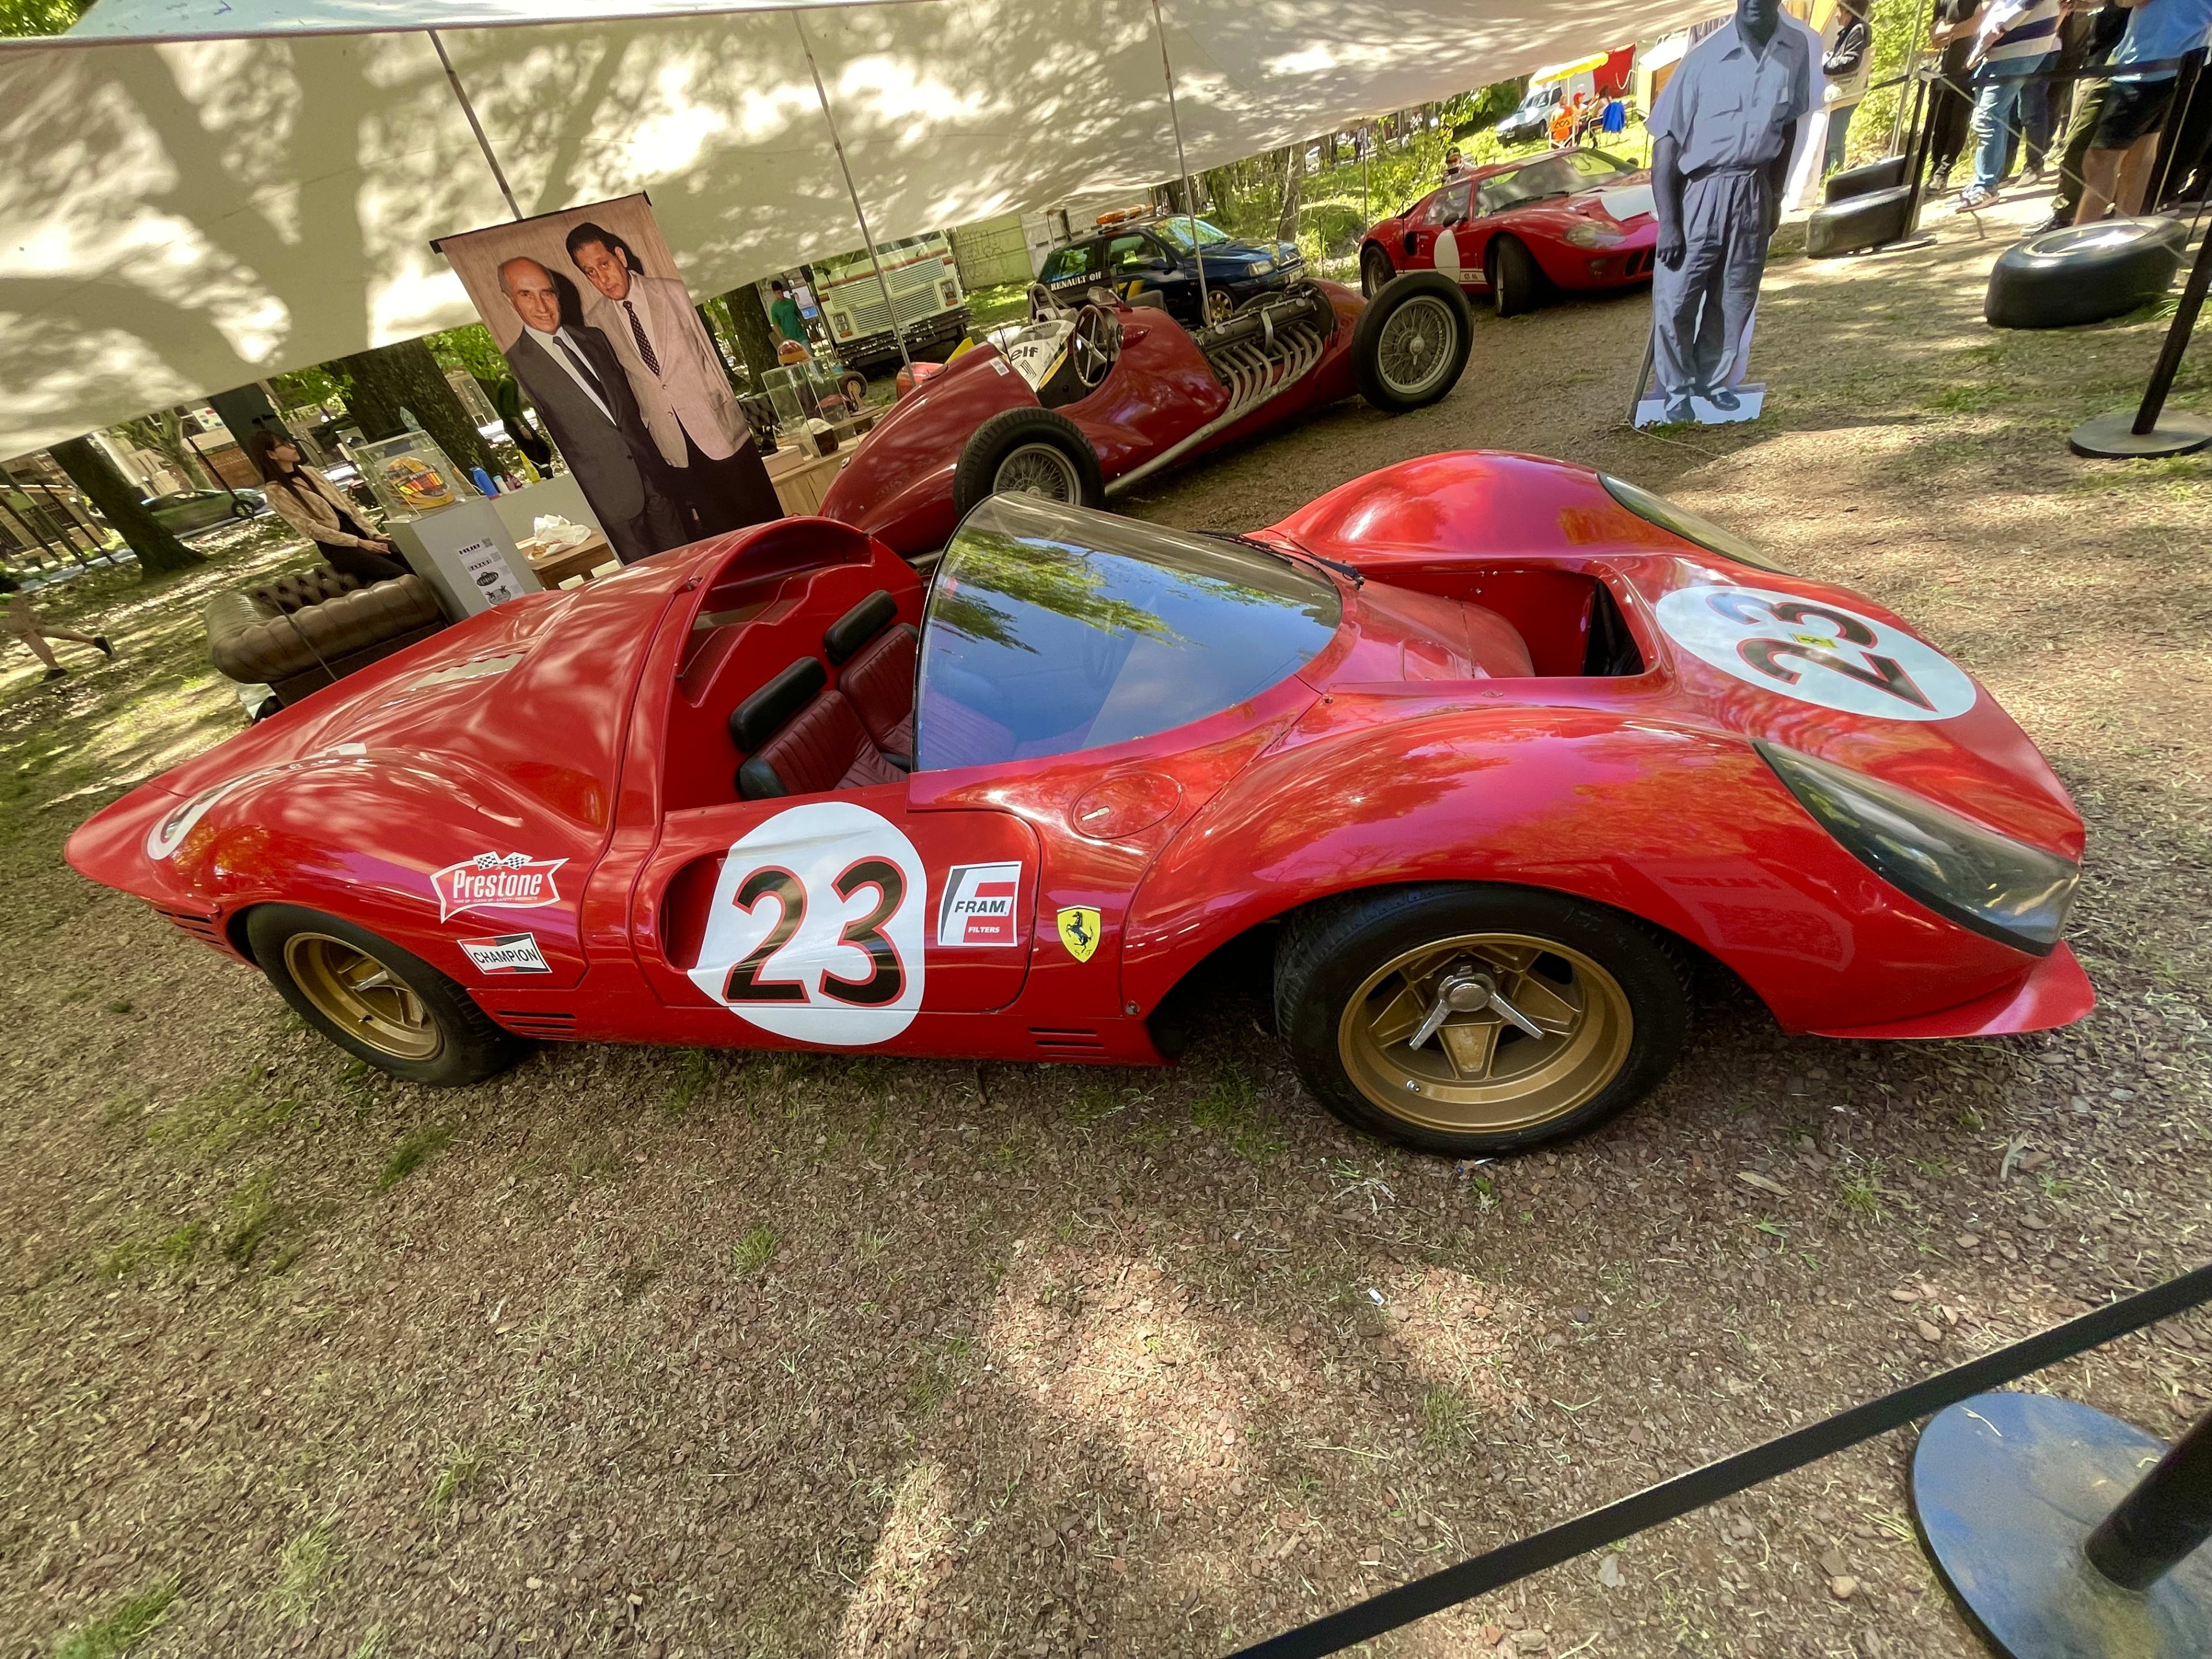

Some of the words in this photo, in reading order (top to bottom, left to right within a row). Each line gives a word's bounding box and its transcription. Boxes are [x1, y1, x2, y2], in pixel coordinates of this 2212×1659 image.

[1050, 275, 1086, 291] RENAULT
[1010, 346, 1038, 361] elf
[1705, 592, 1939, 713] 23
[453, 869, 543, 899] Prestone
[955, 900, 1005, 913] FRAM
[721, 855, 907, 1008] 23
[473, 948, 539, 964] CHAMPION
